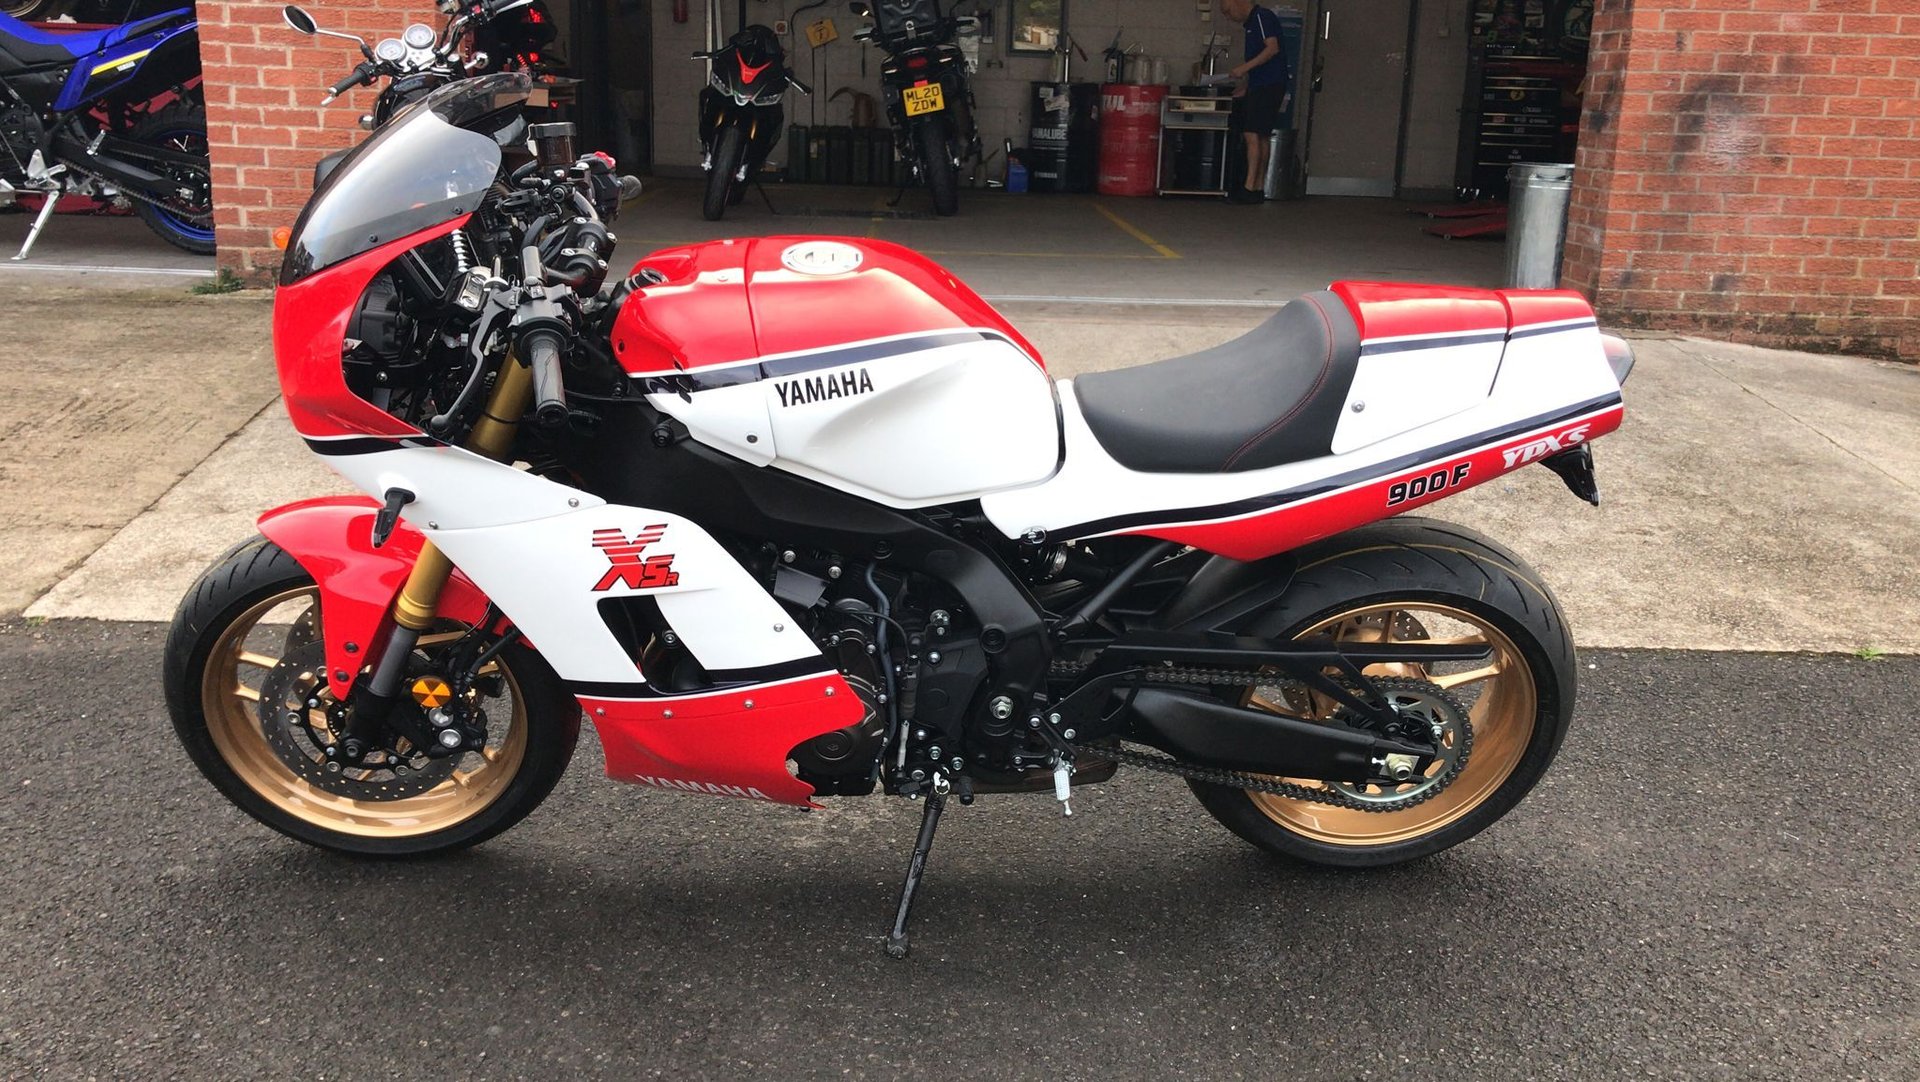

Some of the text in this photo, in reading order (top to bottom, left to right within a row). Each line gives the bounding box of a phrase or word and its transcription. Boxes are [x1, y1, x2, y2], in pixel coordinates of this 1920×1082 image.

[906, 86, 940, 102] ML20
[912, 98, 937, 112] ZDW
[774, 368, 874, 408] YAMAHA
[1386, 461, 1472, 507] 900 F
[634, 774, 772, 800] YAMAHA
